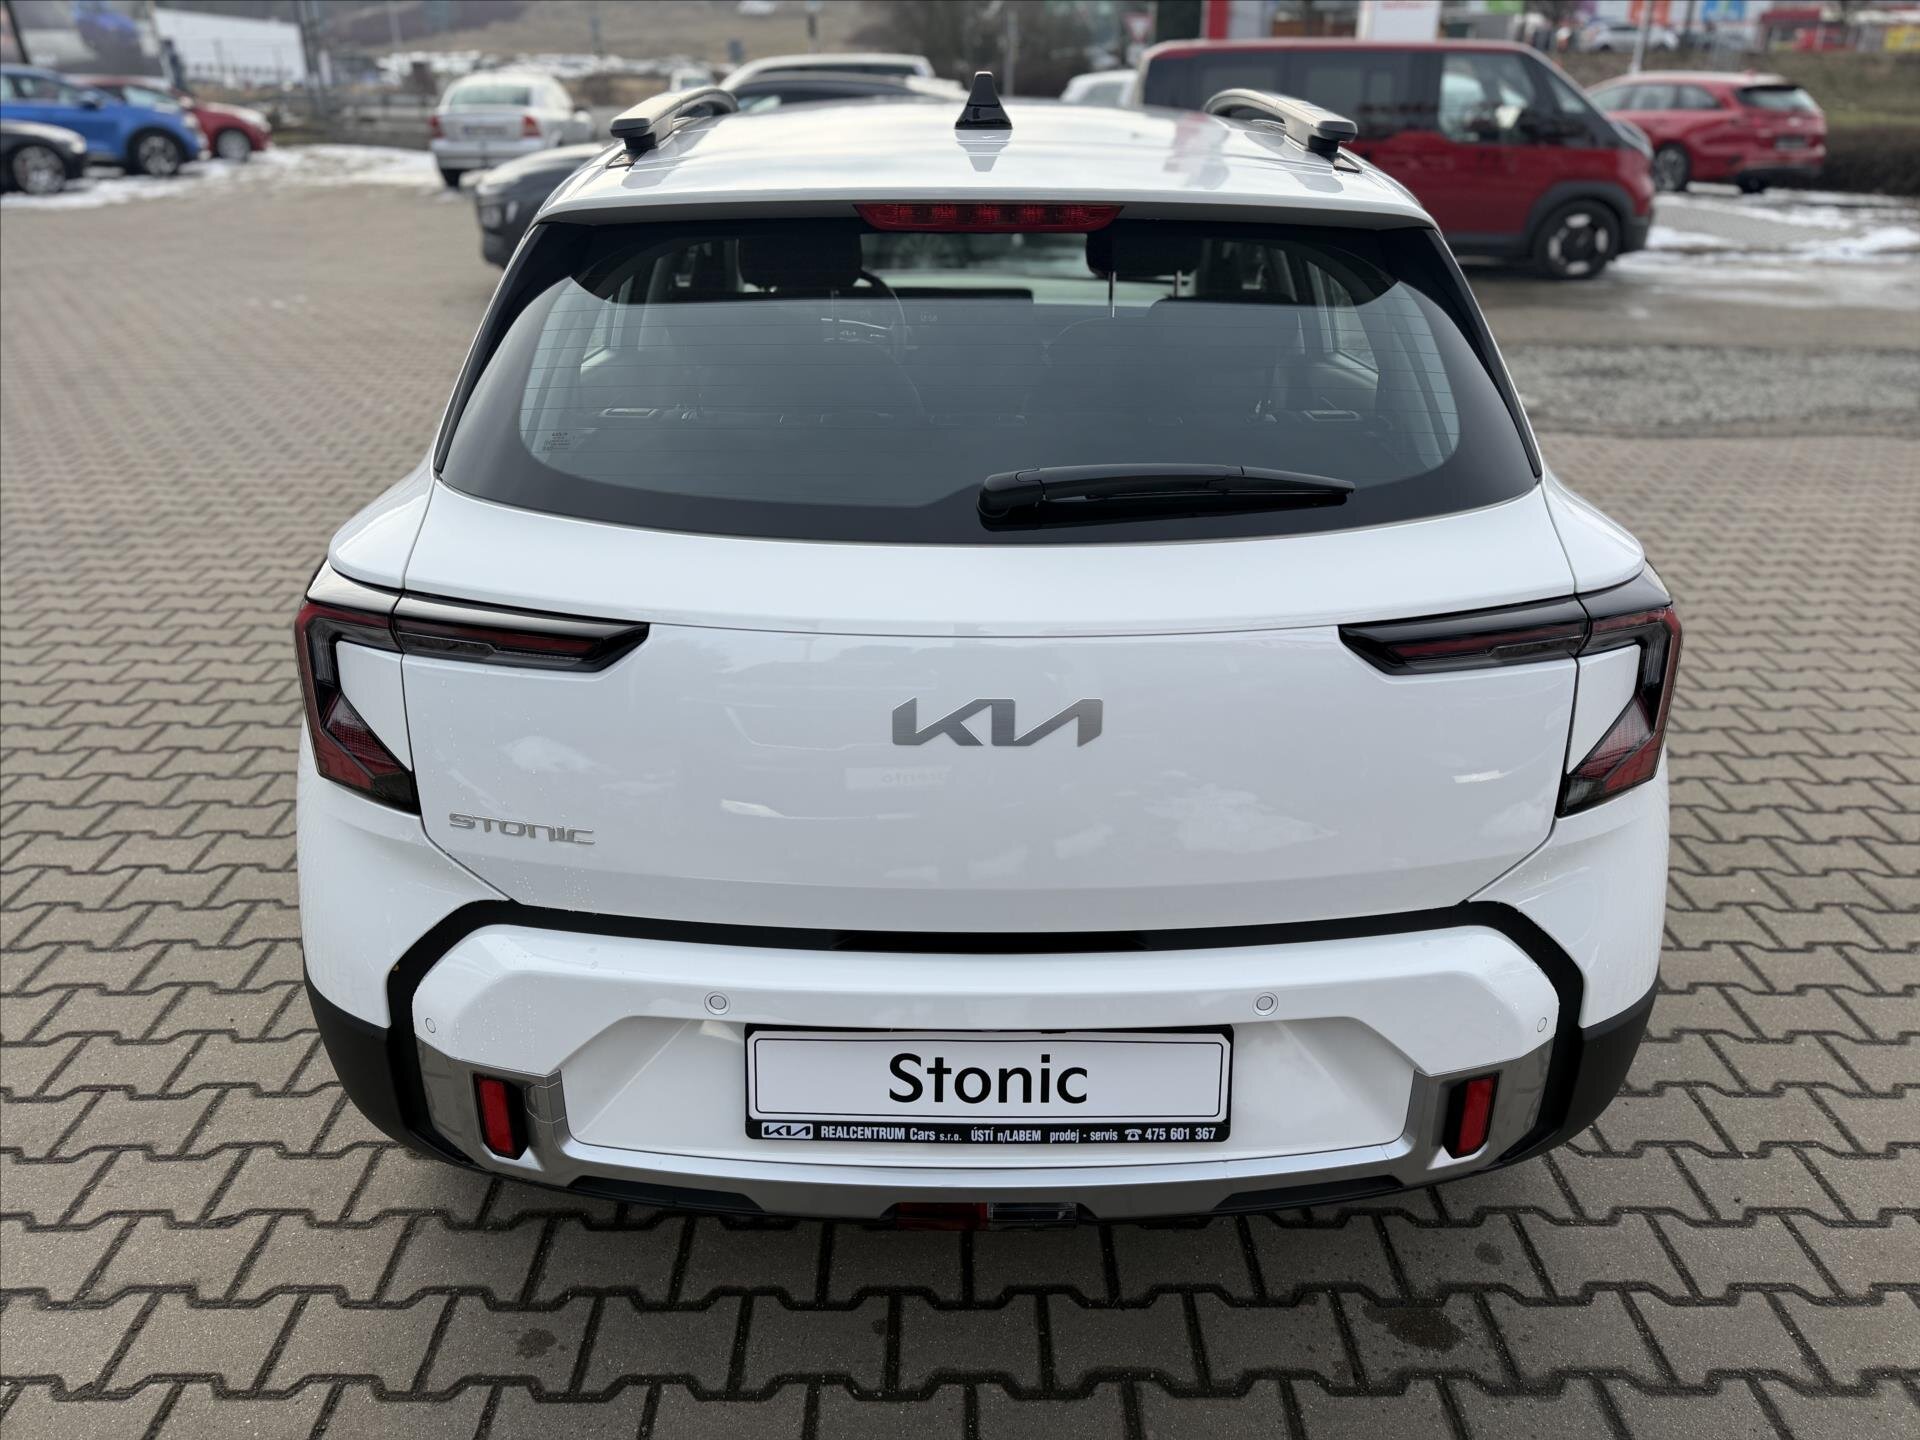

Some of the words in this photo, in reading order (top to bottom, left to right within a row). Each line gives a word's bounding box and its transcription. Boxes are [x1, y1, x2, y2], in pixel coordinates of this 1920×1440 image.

[892, 697, 1103, 747] KIA
[888, 1052, 1088, 1104] Stonic
[763, 1125, 811, 1136] KIA
[820, 1125, 905, 1140] REALCENTRUM
[909, 1128, 936, 1141] Cars
[939, 1133, 962, 1142] s.r.o.
[971, 1127, 994, 1142] ÚSTÍ
[997, 1129, 1041, 1142] n/LABEM
[1050, 1129, 1079, 1143] prodej
[1090, 1129, 1118, 1141] servis
[1145, 1127, 1166, 1141] 475
[1170, 1127, 1190, 1141] 601
[1195, 1127, 1216, 1140] 367
